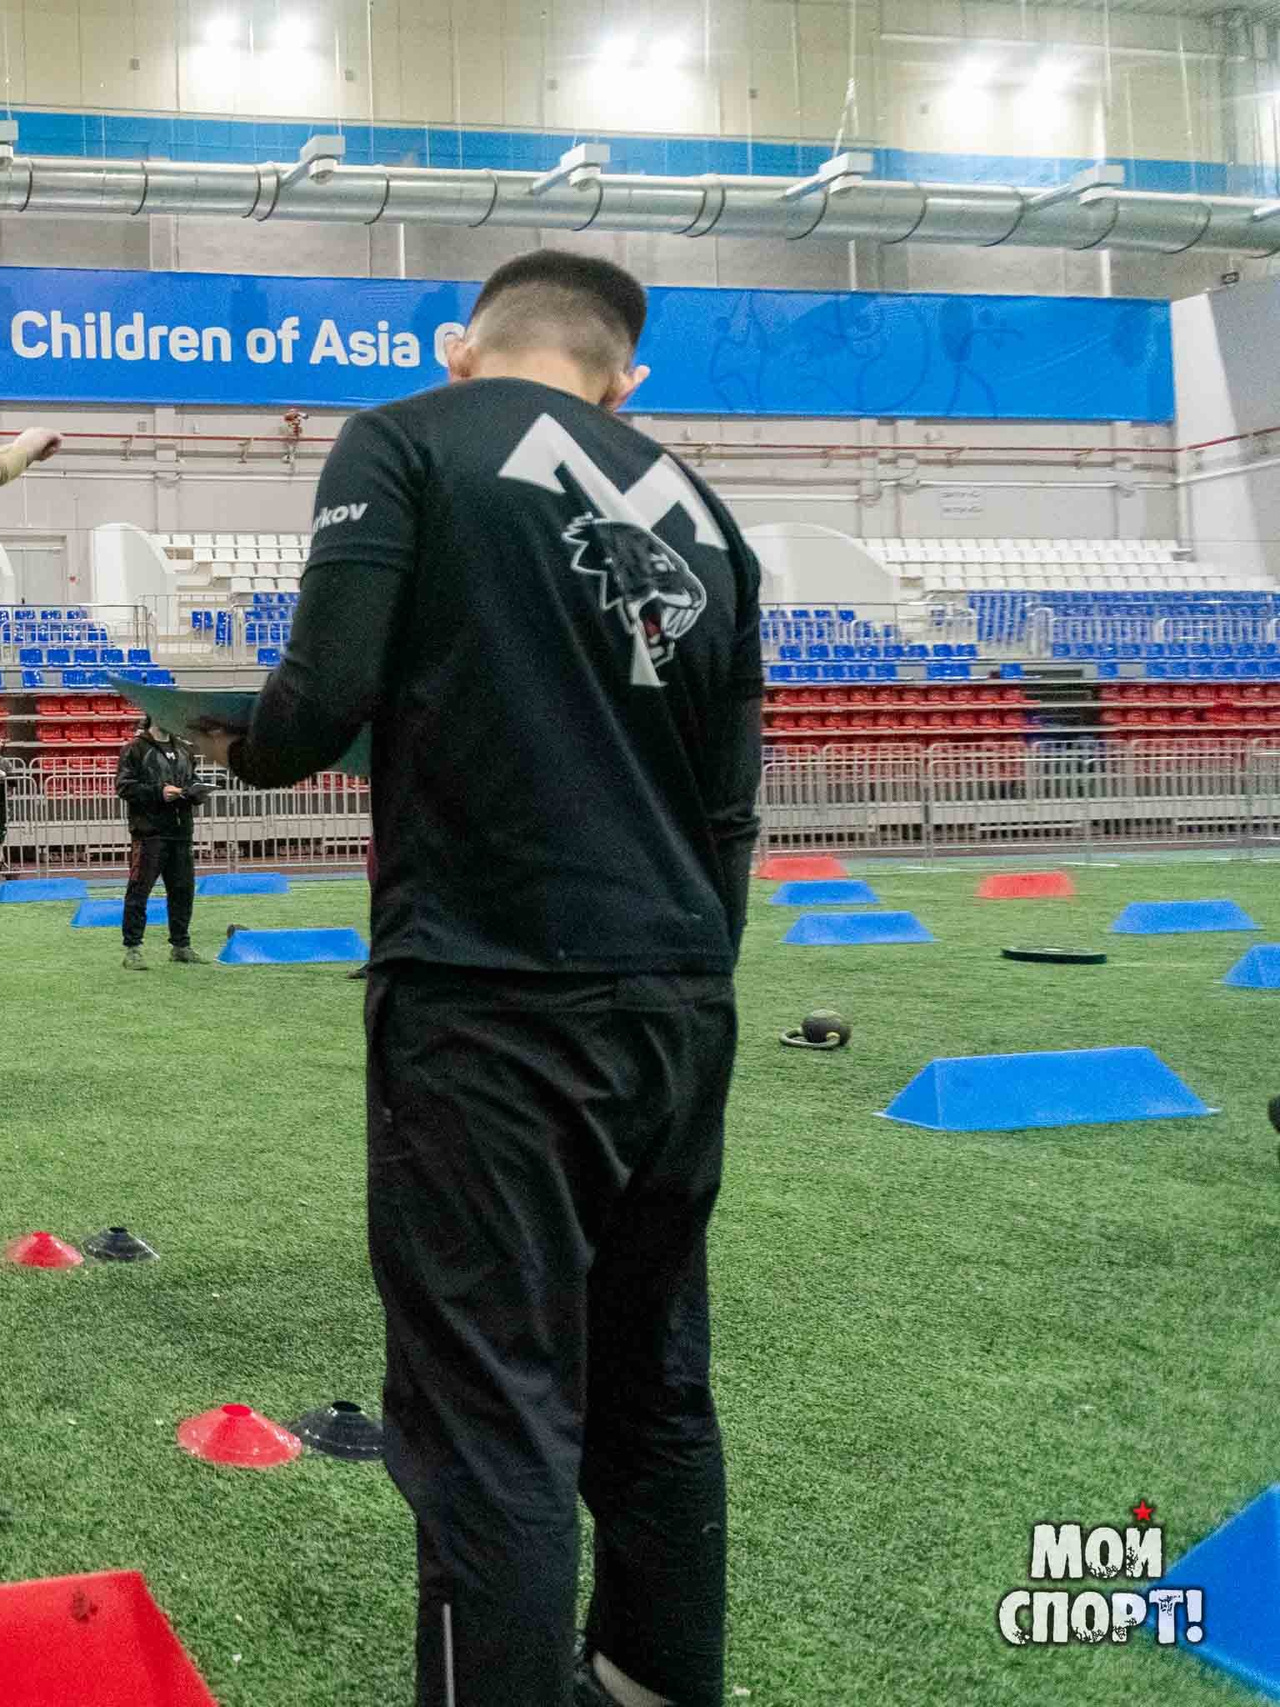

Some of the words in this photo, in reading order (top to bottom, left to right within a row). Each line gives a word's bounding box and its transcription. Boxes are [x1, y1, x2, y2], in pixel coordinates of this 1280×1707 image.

[10, 310, 232, 362] Children
[246, 316, 301, 364] of
[309, 318, 421, 367] Asia
